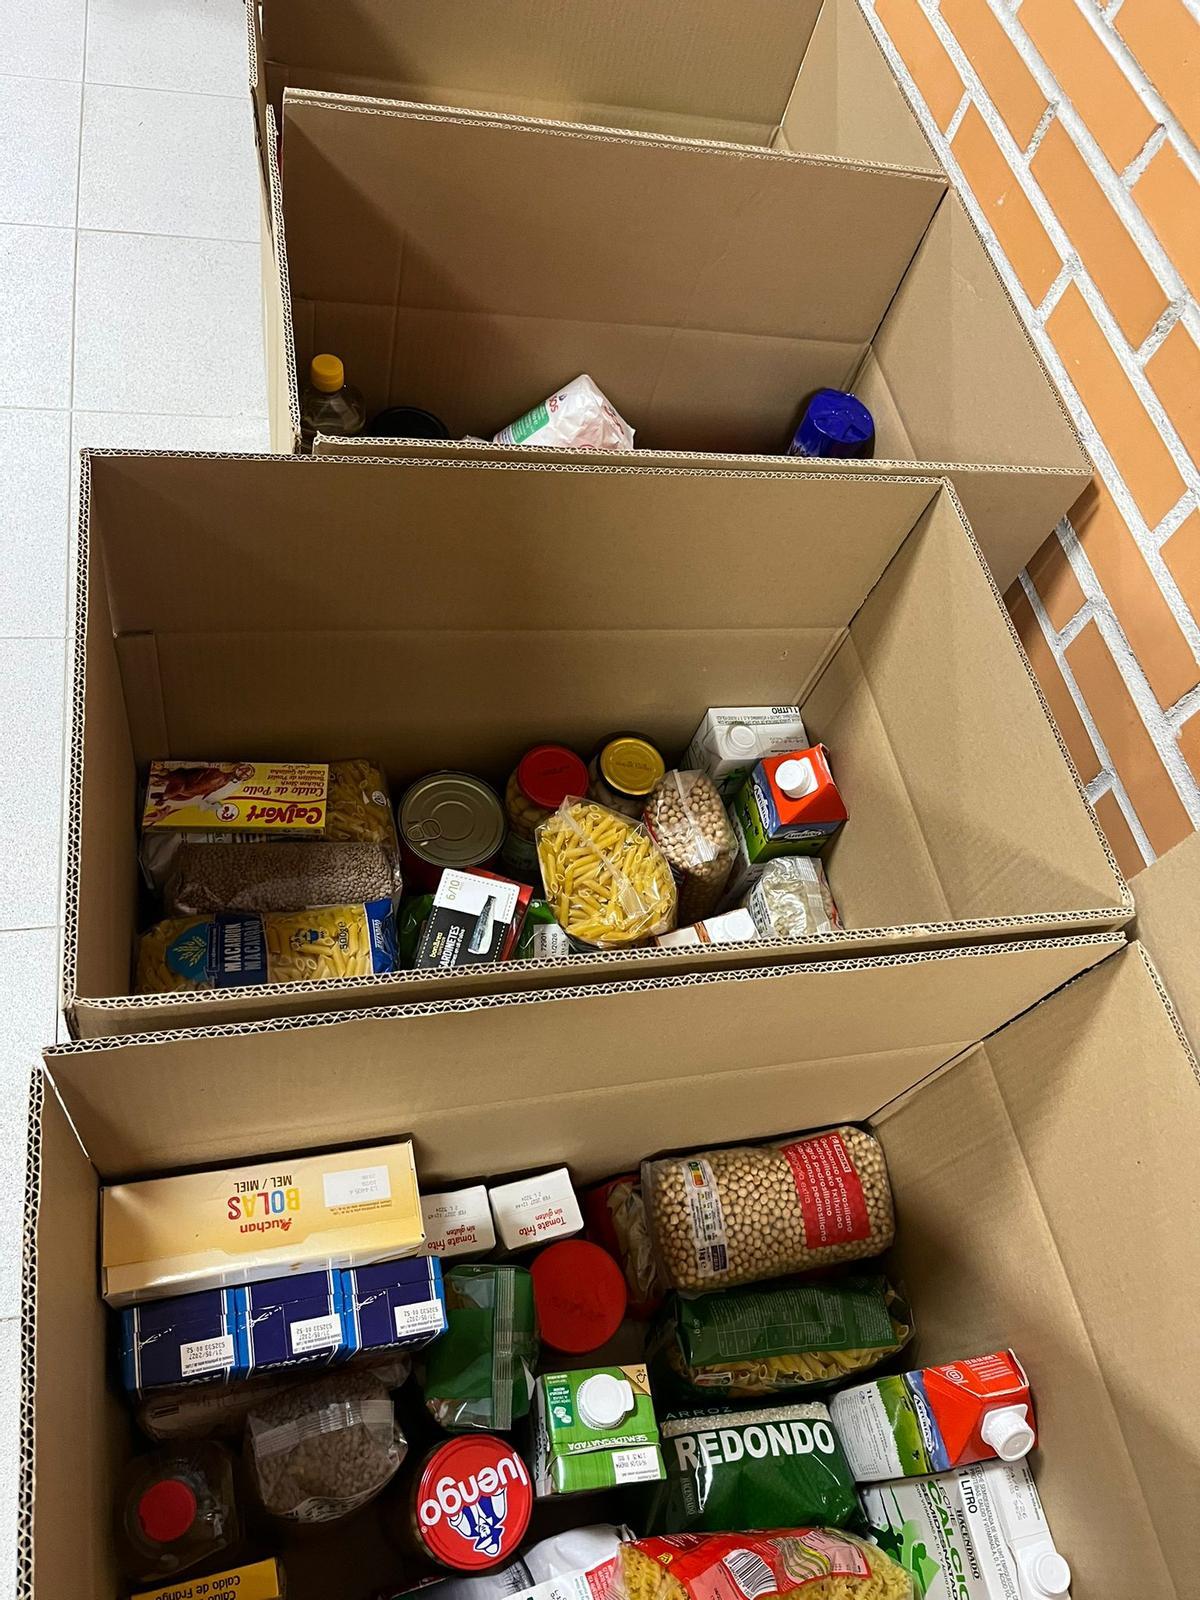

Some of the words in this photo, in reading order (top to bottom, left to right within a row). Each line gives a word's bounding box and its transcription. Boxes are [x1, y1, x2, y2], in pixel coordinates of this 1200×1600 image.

[242, 786, 272, 796] Pollo
[274, 786, 288, 794] de
[291, 786, 324, 797] Caldo
[246, 805, 322, 824] CalNort
[446, 880, 460, 900] 6/10
[835, 1146, 851, 1172] EROSKI
[234, 1180, 260, 1194] MIEL
[262, 1178, 268, 1190] /
[270, 1175, 292, 1188] MEL
[812, 1162, 832, 1216] pedrosillano
[820, 1138, 840, 1175] Garbanzo
[836, 1176, 853, 1233] pedrosillano
[800, 1182, 811, 1204] extra
[227, 1188, 300, 1220] BOLAS
[832, 1188, 843, 1229] txitxirioa
[536, 1208, 553, 1220] gluten
[812, 1186, 827, 1242] pedrosillano
[240, 1218, 292, 1234] Auchan
[446, 1224, 466, 1236] gluten
[518, 1224, 537, 1236] frito
[538, 1217, 566, 1231] Tomate
[428, 1239, 446, 1250] frito
[447, 1234, 477, 1246] Tomate
[666, 1406, 733, 1420] ARROZ
[674, 1422, 835, 1472] REDONDO
[420, 1452, 528, 1526] luengo
[961, 1480, 978, 1514] LITRO
[914, 1483, 924, 1498] CON
[920, 1497, 936, 1534] VITAMINAS
[936, 1478, 955, 1526] LECHE
[974, 1466, 985, 1485] LECHE
[992, 1533, 1001, 1547] VACA
[928, 1480, 970, 1600] CALCIO
[956, 1508, 980, 1580] HACENDADO
[196, 1584, 209, 1594] de
[212, 1575, 240, 1588] Caldo
